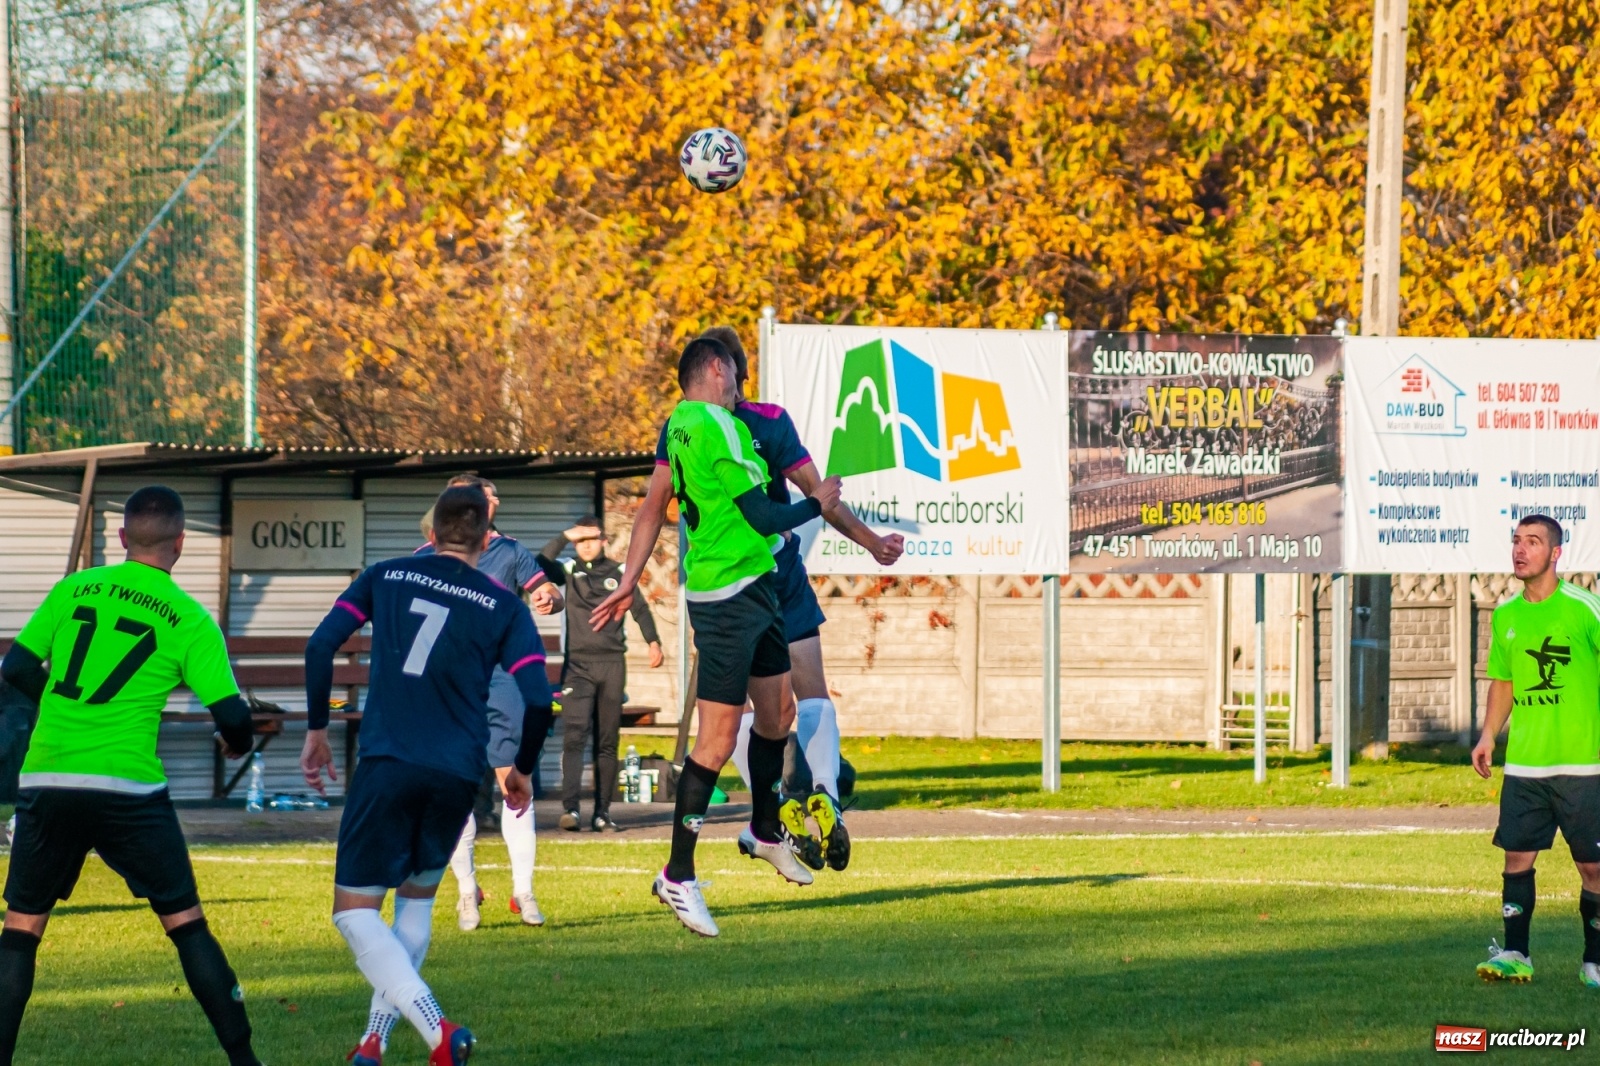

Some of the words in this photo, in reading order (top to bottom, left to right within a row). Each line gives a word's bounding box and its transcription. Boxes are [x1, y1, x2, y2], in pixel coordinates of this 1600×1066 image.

[1093, 345, 1314, 377] ŚLUSARSTWO-KOWALSTWO
[1478, 383, 1494, 403] tel.
[1497, 383, 1516, 403] 604
[1519, 383, 1538, 403] 507
[1540, 383, 1560, 403] 320
[1386, 402, 1445, 418] DAW-BUD
[1478, 409, 1490, 430] ul.
[1493, 408, 1532, 430] Główna
[1534, 409, 1544, 430] 18
[1553, 408, 1599, 430] Tworków
[1126, 447, 1188, 474] Marek
[1191, 447, 1281, 475] Zawadzki
[1378, 469, 1431, 489] Docieplenia
[1433, 469, 1479, 489] budynków
[1510, 469, 1551, 489] Wynajem
[1553, 469, 1599, 488] rusztowań
[915, 491, 1024, 524] raciborski
[1141, 501, 1168, 525] tel.
[1171, 502, 1202, 525] 504
[1206, 502, 1234, 525] 165
[1238, 502, 1267, 525] 816
[1378, 502, 1441, 522] Kompleksowe
[1553, 503, 1587, 526] sprzętu
[251, 518, 346, 549] GOŚCIE
[905, 538, 953, 556] oaza
[967, 535, 1023, 556] kultur
[1378, 524, 1437, 546] wykończenia
[1439, 529, 1470, 549] wnętrz
[1083, 534, 1138, 558] 47-451
[1141, 533, 1219, 560] Tworków,
[1222, 534, 1243, 558] ul.
[1247, 535, 1255, 558] 1
[1260, 535, 1300, 563] Maja
[1303, 535, 1322, 558] 10
[384, 569, 405, 581] LKS
[405, 571, 497, 611] KRZYŻANOWICE
[72, 582, 103, 599] LKS
[108, 583, 181, 629] TWORKÓW
[402, 597, 450, 677] 7
[51, 605, 157, 704] 17
